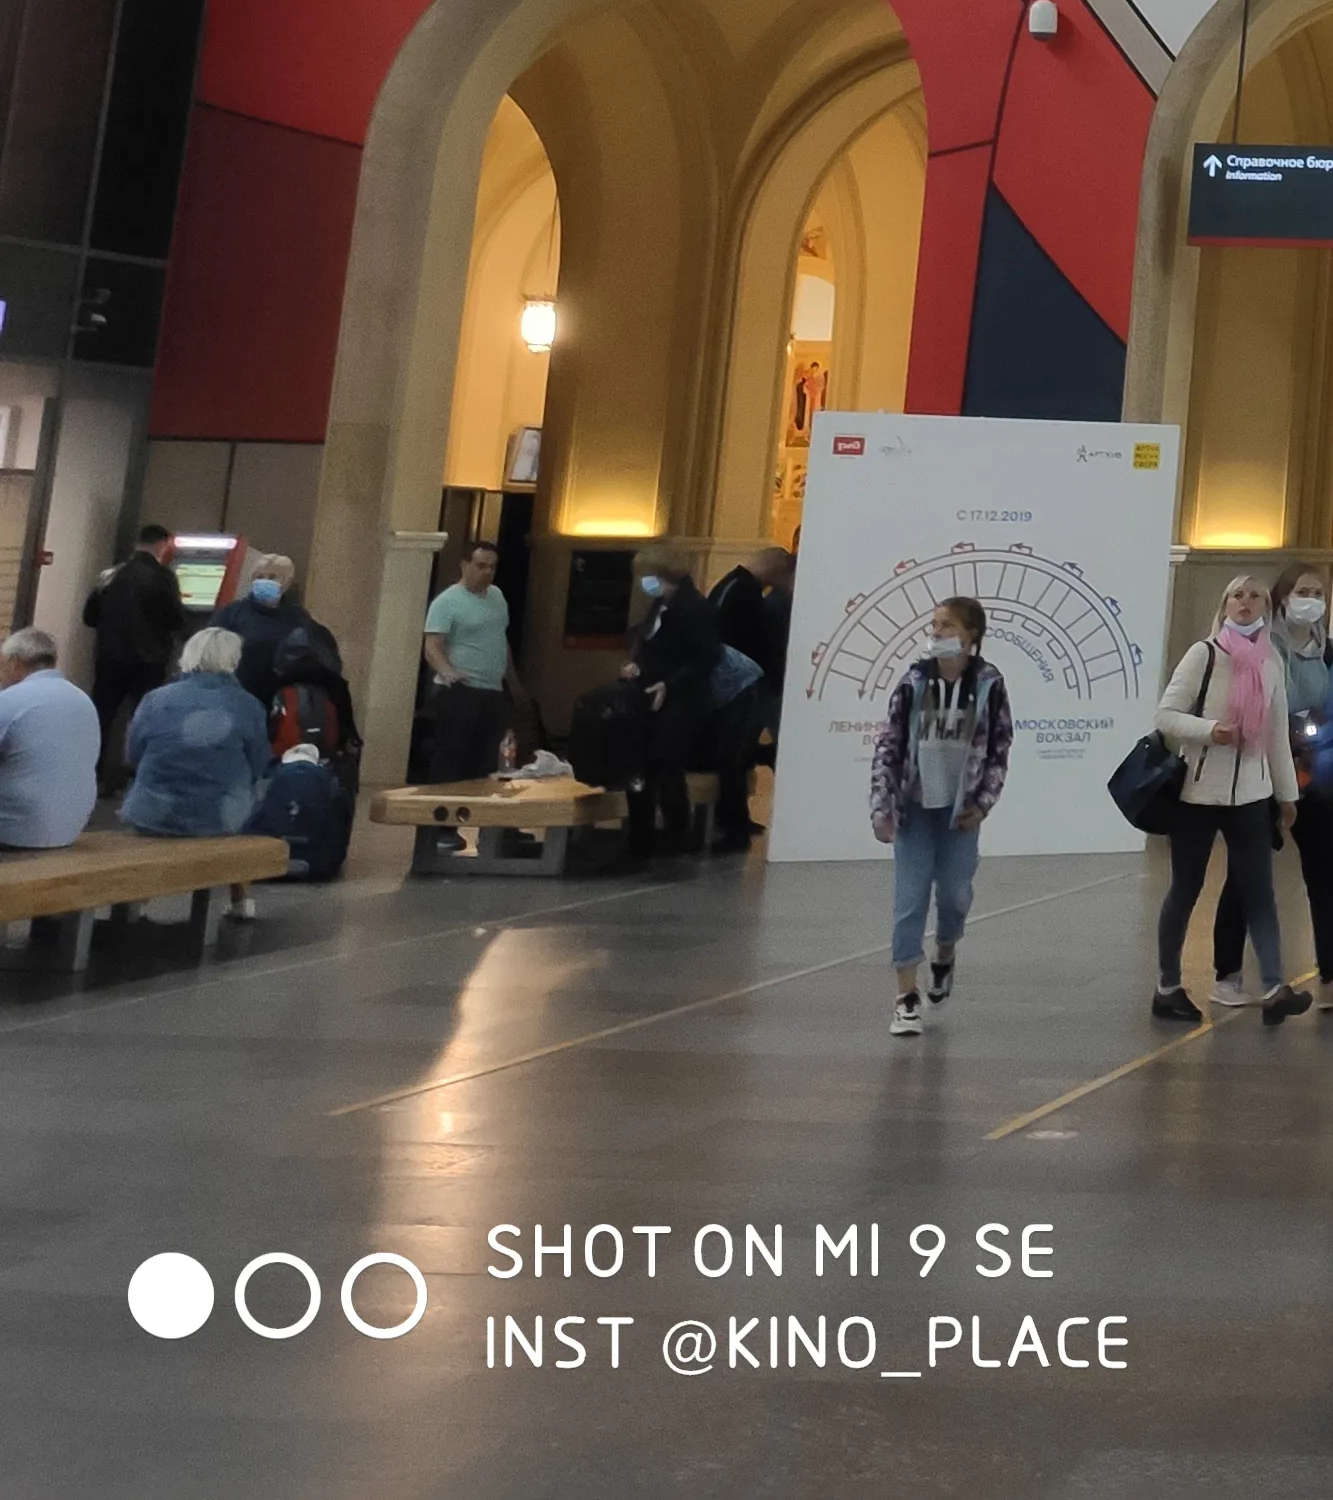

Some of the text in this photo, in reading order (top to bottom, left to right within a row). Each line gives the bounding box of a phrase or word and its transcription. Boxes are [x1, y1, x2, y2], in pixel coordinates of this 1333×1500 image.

[1226, 155, 1304, 169] Справочное
[1226, 170, 1282, 181] Information
[984, 626, 1055, 684] СООБЩЕНИЯ
[1015, 717, 1114, 730] МОСКОВСКИЙ
[1036, 732, 1091, 743] ВОКЗАЛ
